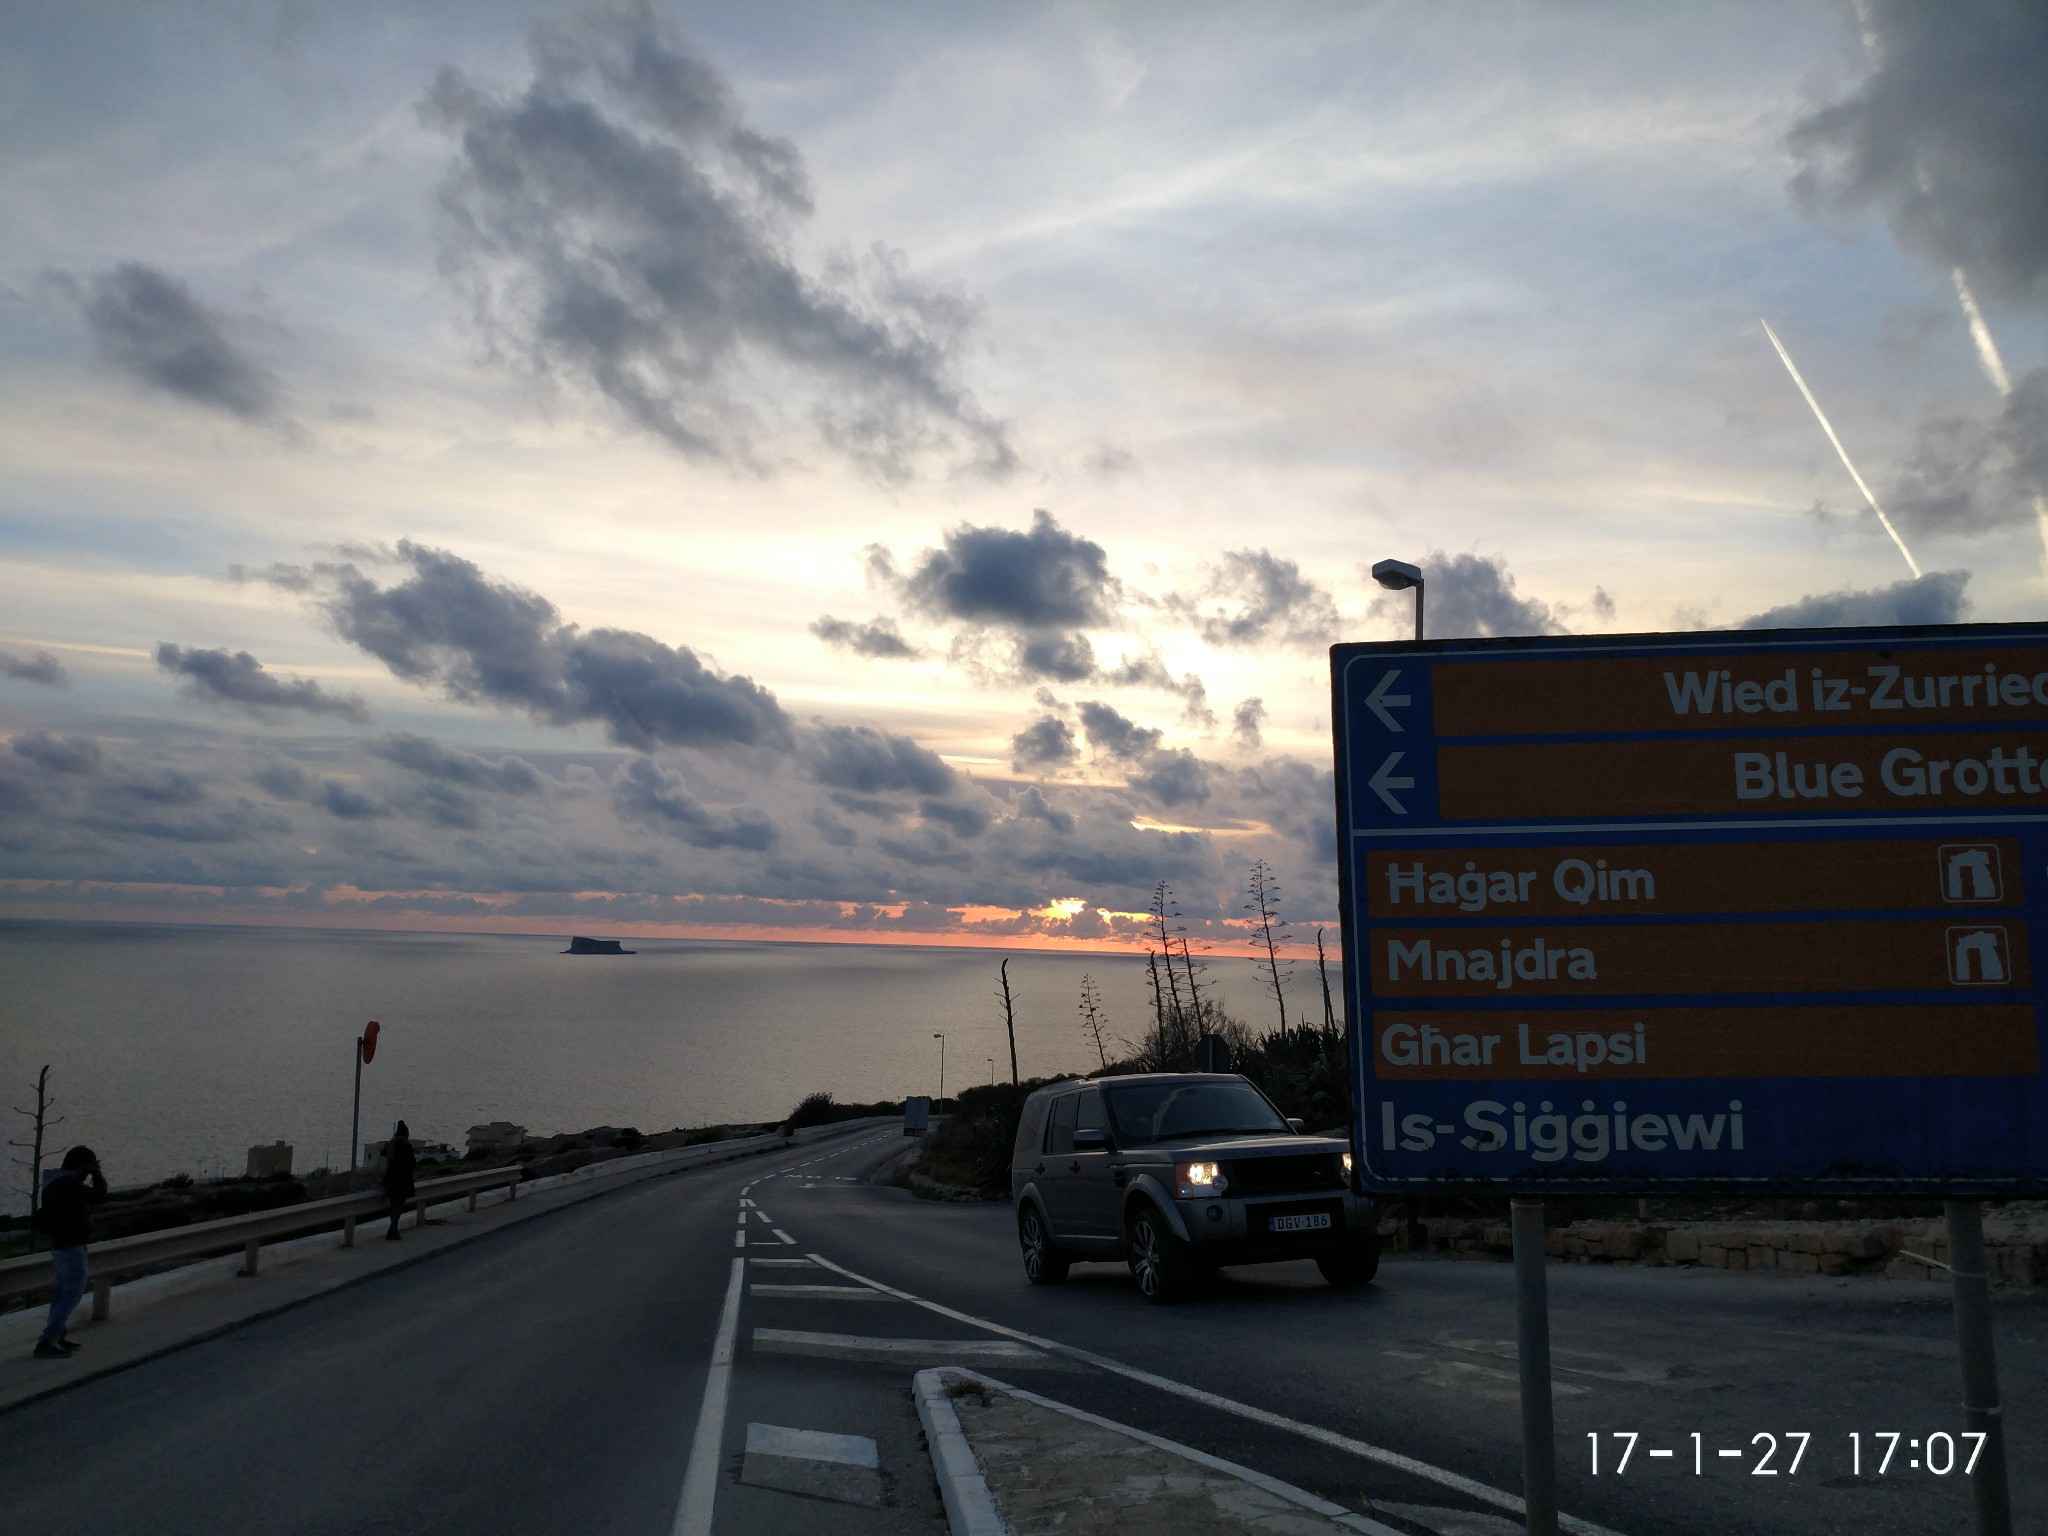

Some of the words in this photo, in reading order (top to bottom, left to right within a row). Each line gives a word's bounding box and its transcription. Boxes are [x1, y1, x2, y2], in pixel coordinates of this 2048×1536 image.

[1664, 667, 1798, 714] Wied
[1733, 751, 1864, 800] Blue
[1552, 858, 1655, 905] Qim
[1387, 938, 1597, 990] Mnajdra
[1381, 1023, 1501, 1067] Għar
[1518, 1021, 1646, 1073] Lapsi
[1380, 1099, 1744, 1163] Is-Siġġiewi
